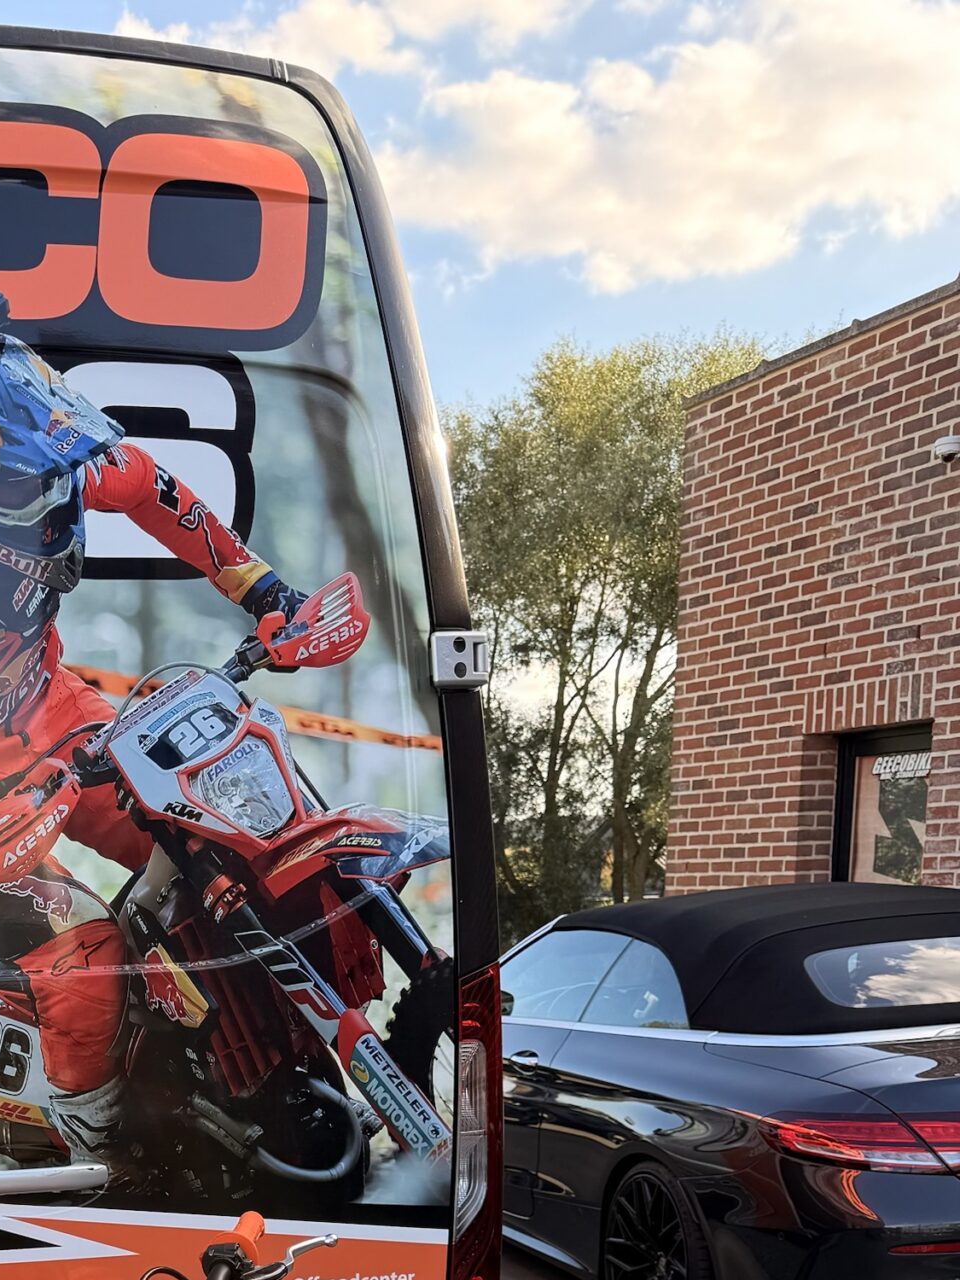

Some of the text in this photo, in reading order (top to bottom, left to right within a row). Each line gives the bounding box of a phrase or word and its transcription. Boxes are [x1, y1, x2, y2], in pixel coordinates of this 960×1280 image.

[168, 708, 227, 758] 26
[162, 801, 204, 823] KTM
[360, 1037, 432, 1124] METZELER
[366, 1077, 429, 1153] MOTOREX
